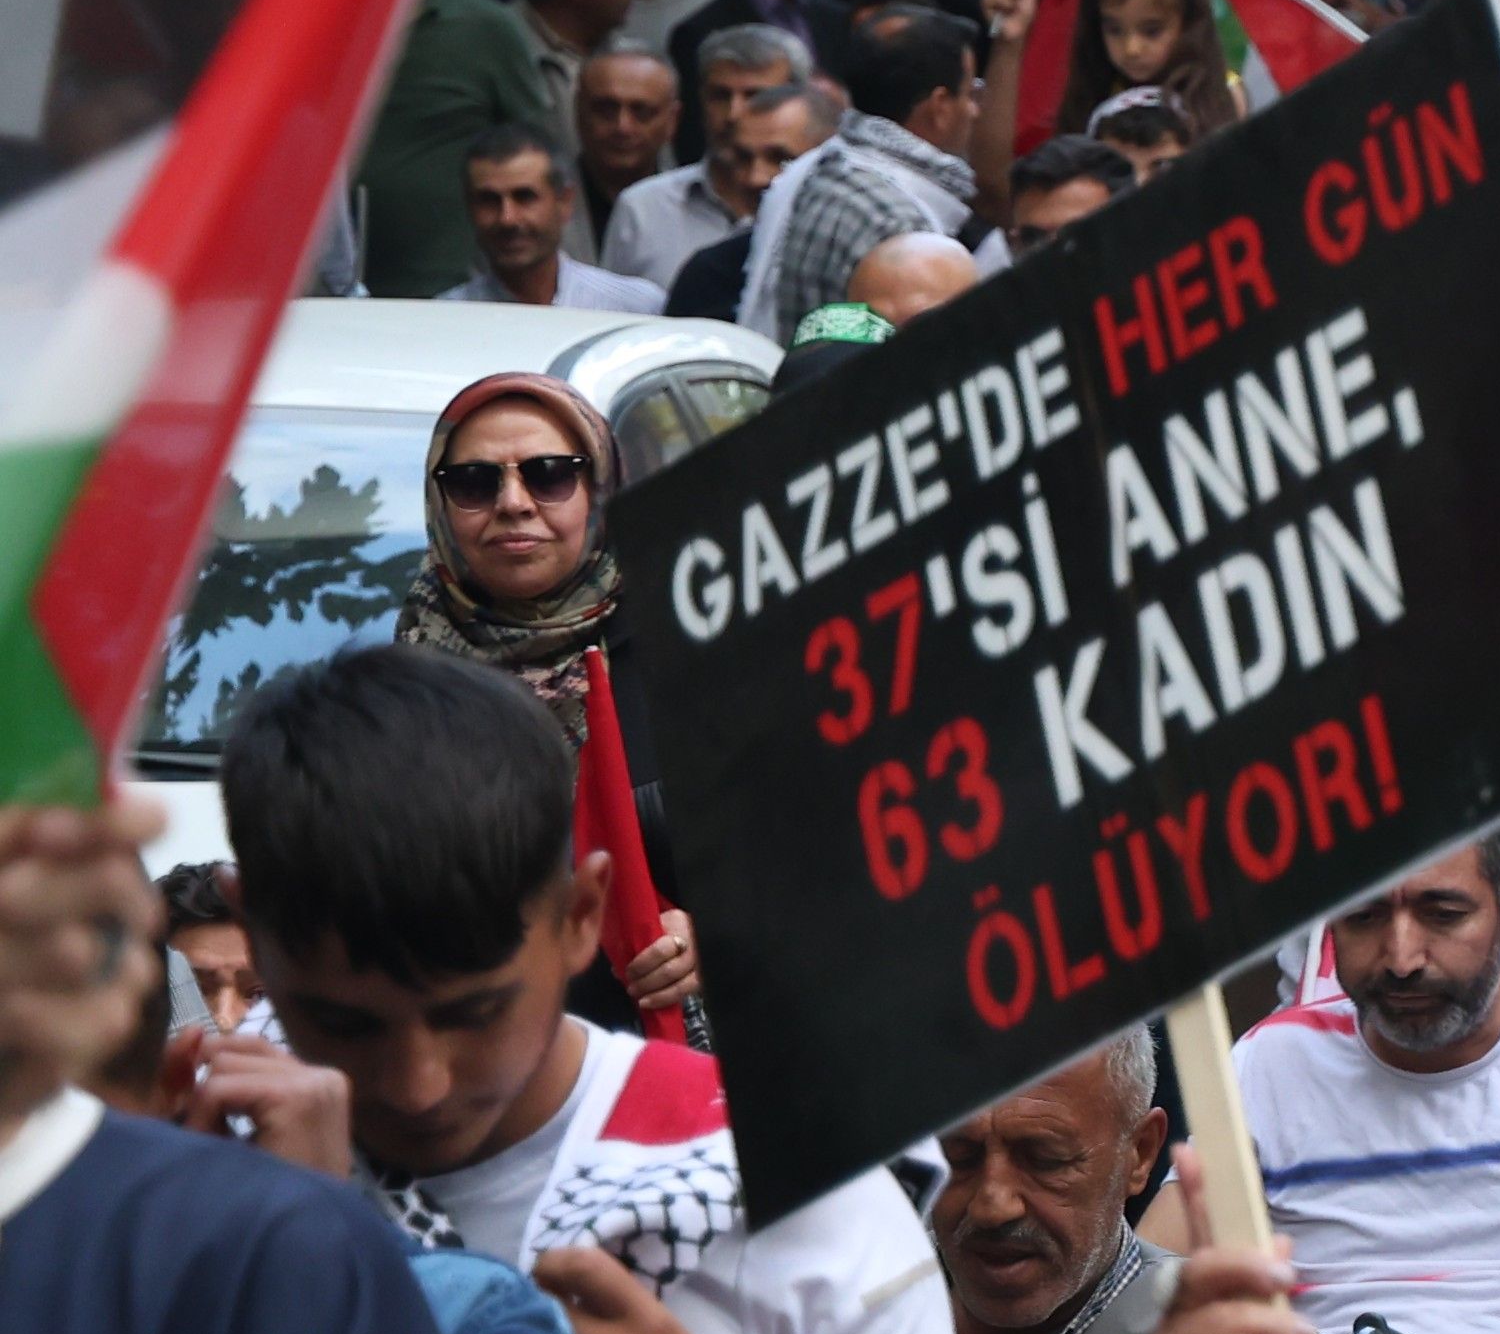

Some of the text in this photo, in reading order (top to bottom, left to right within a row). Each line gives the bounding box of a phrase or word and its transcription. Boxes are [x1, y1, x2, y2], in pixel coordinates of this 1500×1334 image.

[670, 80, 1486, 643] GAZZE'DE HER GÜN
[1107, 305, 1426, 589] ANNE,
[857, 477, 1405, 901] 63 KADIN
[966, 694, 1405, 1031] ÖLÜYOR!
